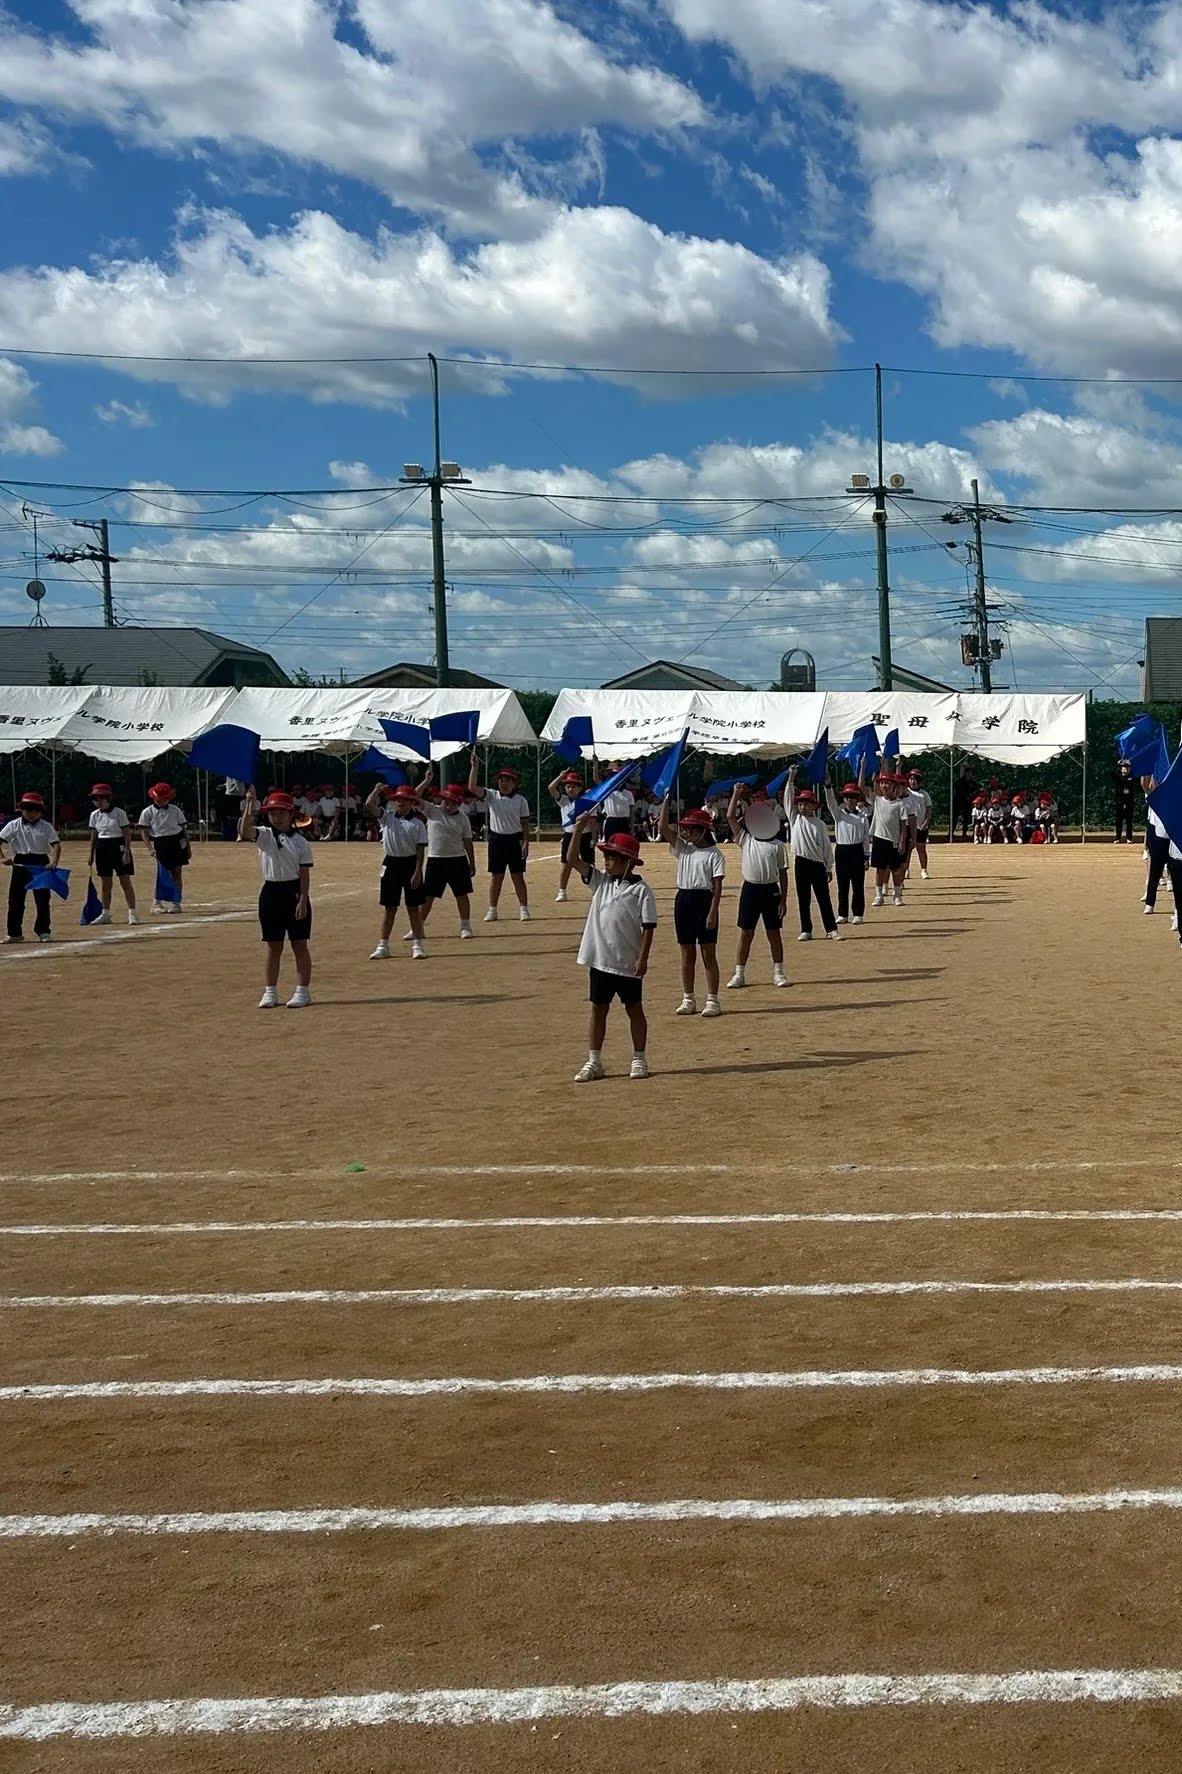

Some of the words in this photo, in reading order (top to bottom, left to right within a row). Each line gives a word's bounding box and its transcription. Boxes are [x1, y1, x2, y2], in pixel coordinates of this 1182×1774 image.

[289, 708, 430, 726] 香里ヌヴェール学院小学
[614, 712, 767, 728] 香里ヌヴェール学院小学校
[870, 711, 1039, 735] 聖母女学院
